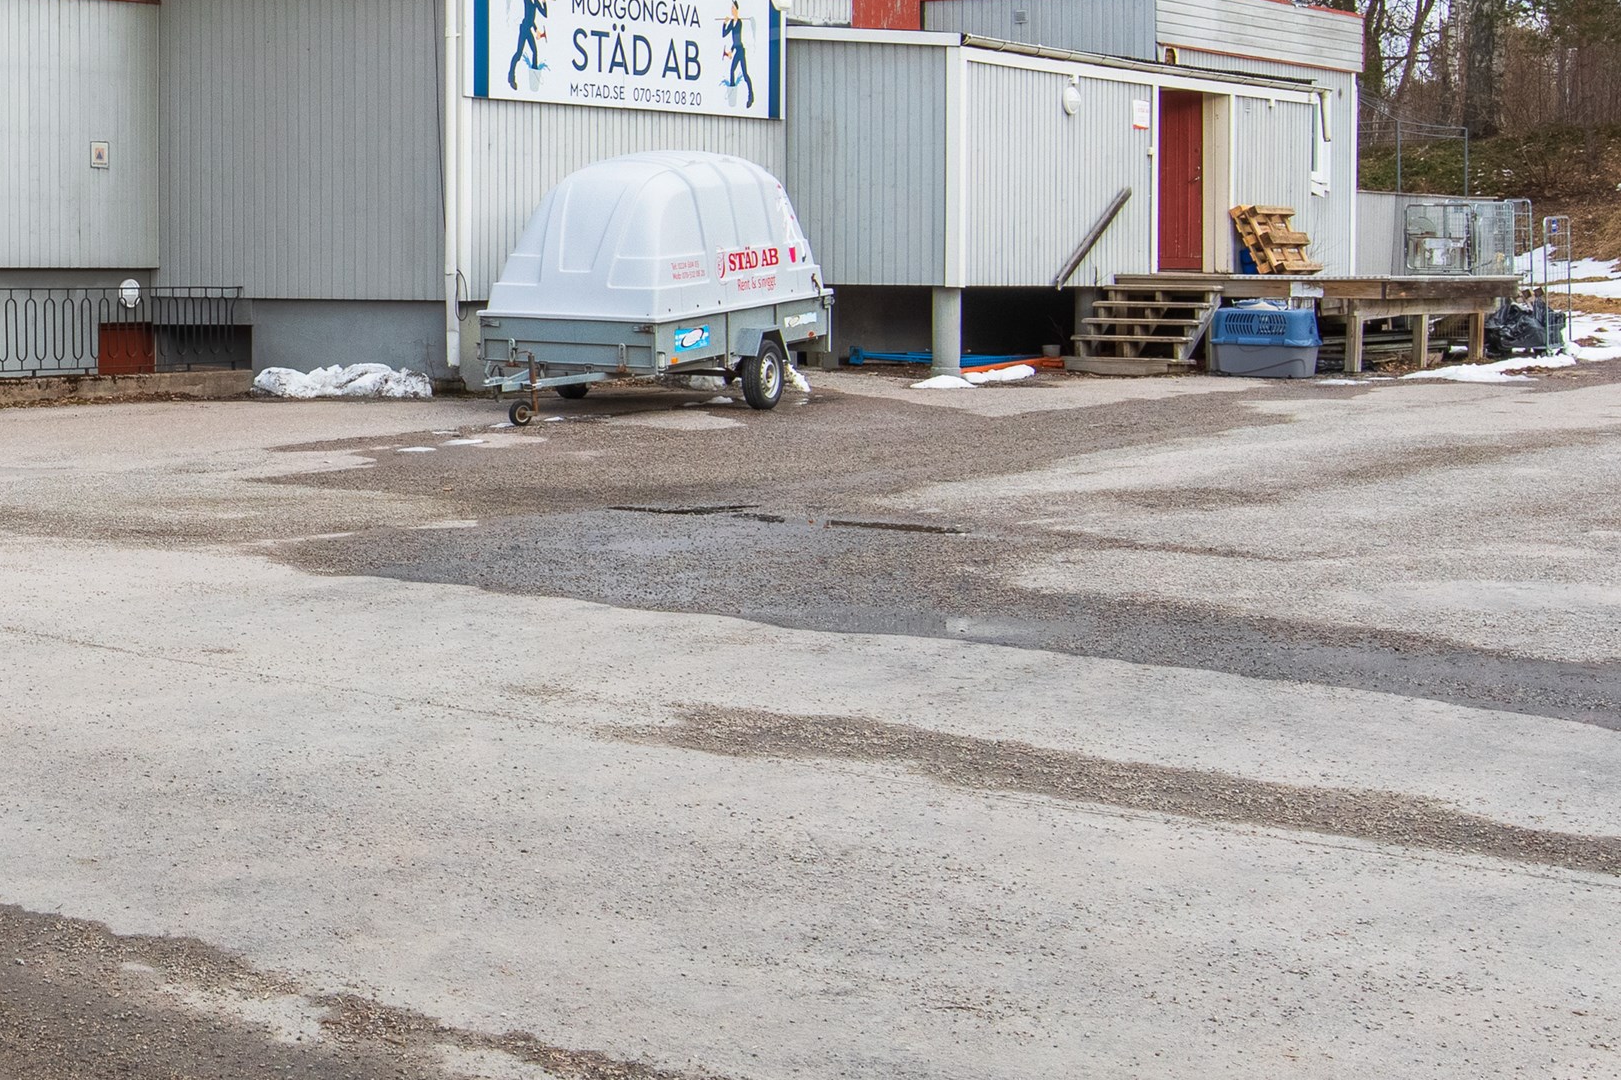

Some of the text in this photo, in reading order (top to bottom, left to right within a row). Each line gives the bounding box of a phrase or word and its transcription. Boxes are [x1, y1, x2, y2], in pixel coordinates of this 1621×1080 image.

[572, 24, 701, 81] STÄD AB
[570, 83, 702, 107] M-STAD.SE 070-512 08 20
[728, 246, 779, 272] STÄD AB
